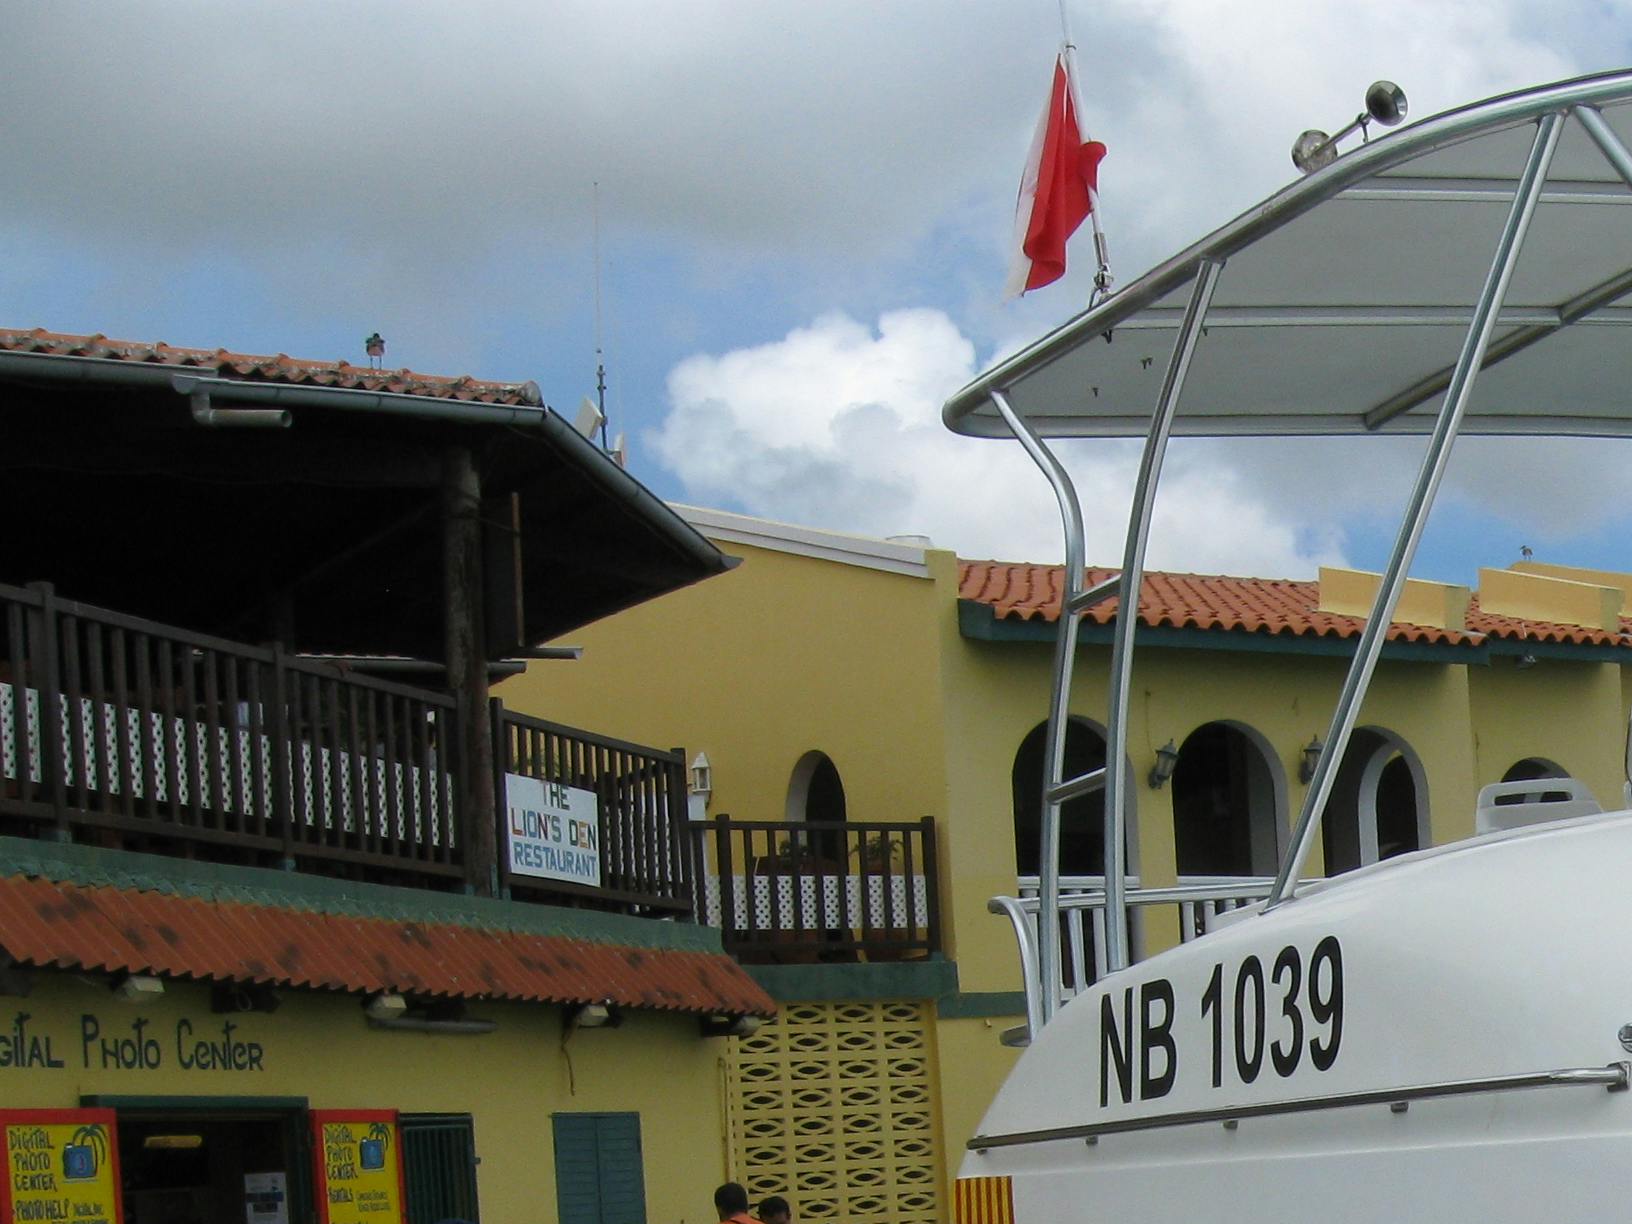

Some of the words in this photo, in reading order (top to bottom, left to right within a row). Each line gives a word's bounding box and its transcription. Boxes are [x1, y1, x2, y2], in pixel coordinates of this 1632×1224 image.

[542, 781, 571, 811] THE
[510, 807, 562, 843] LION'S
[568, 818, 597, 852] DEN
[512, 841, 597, 878] RESTAURANT
[1100, 978, 1177, 1108] NB
[1201, 935, 1344, 1088] 1039
